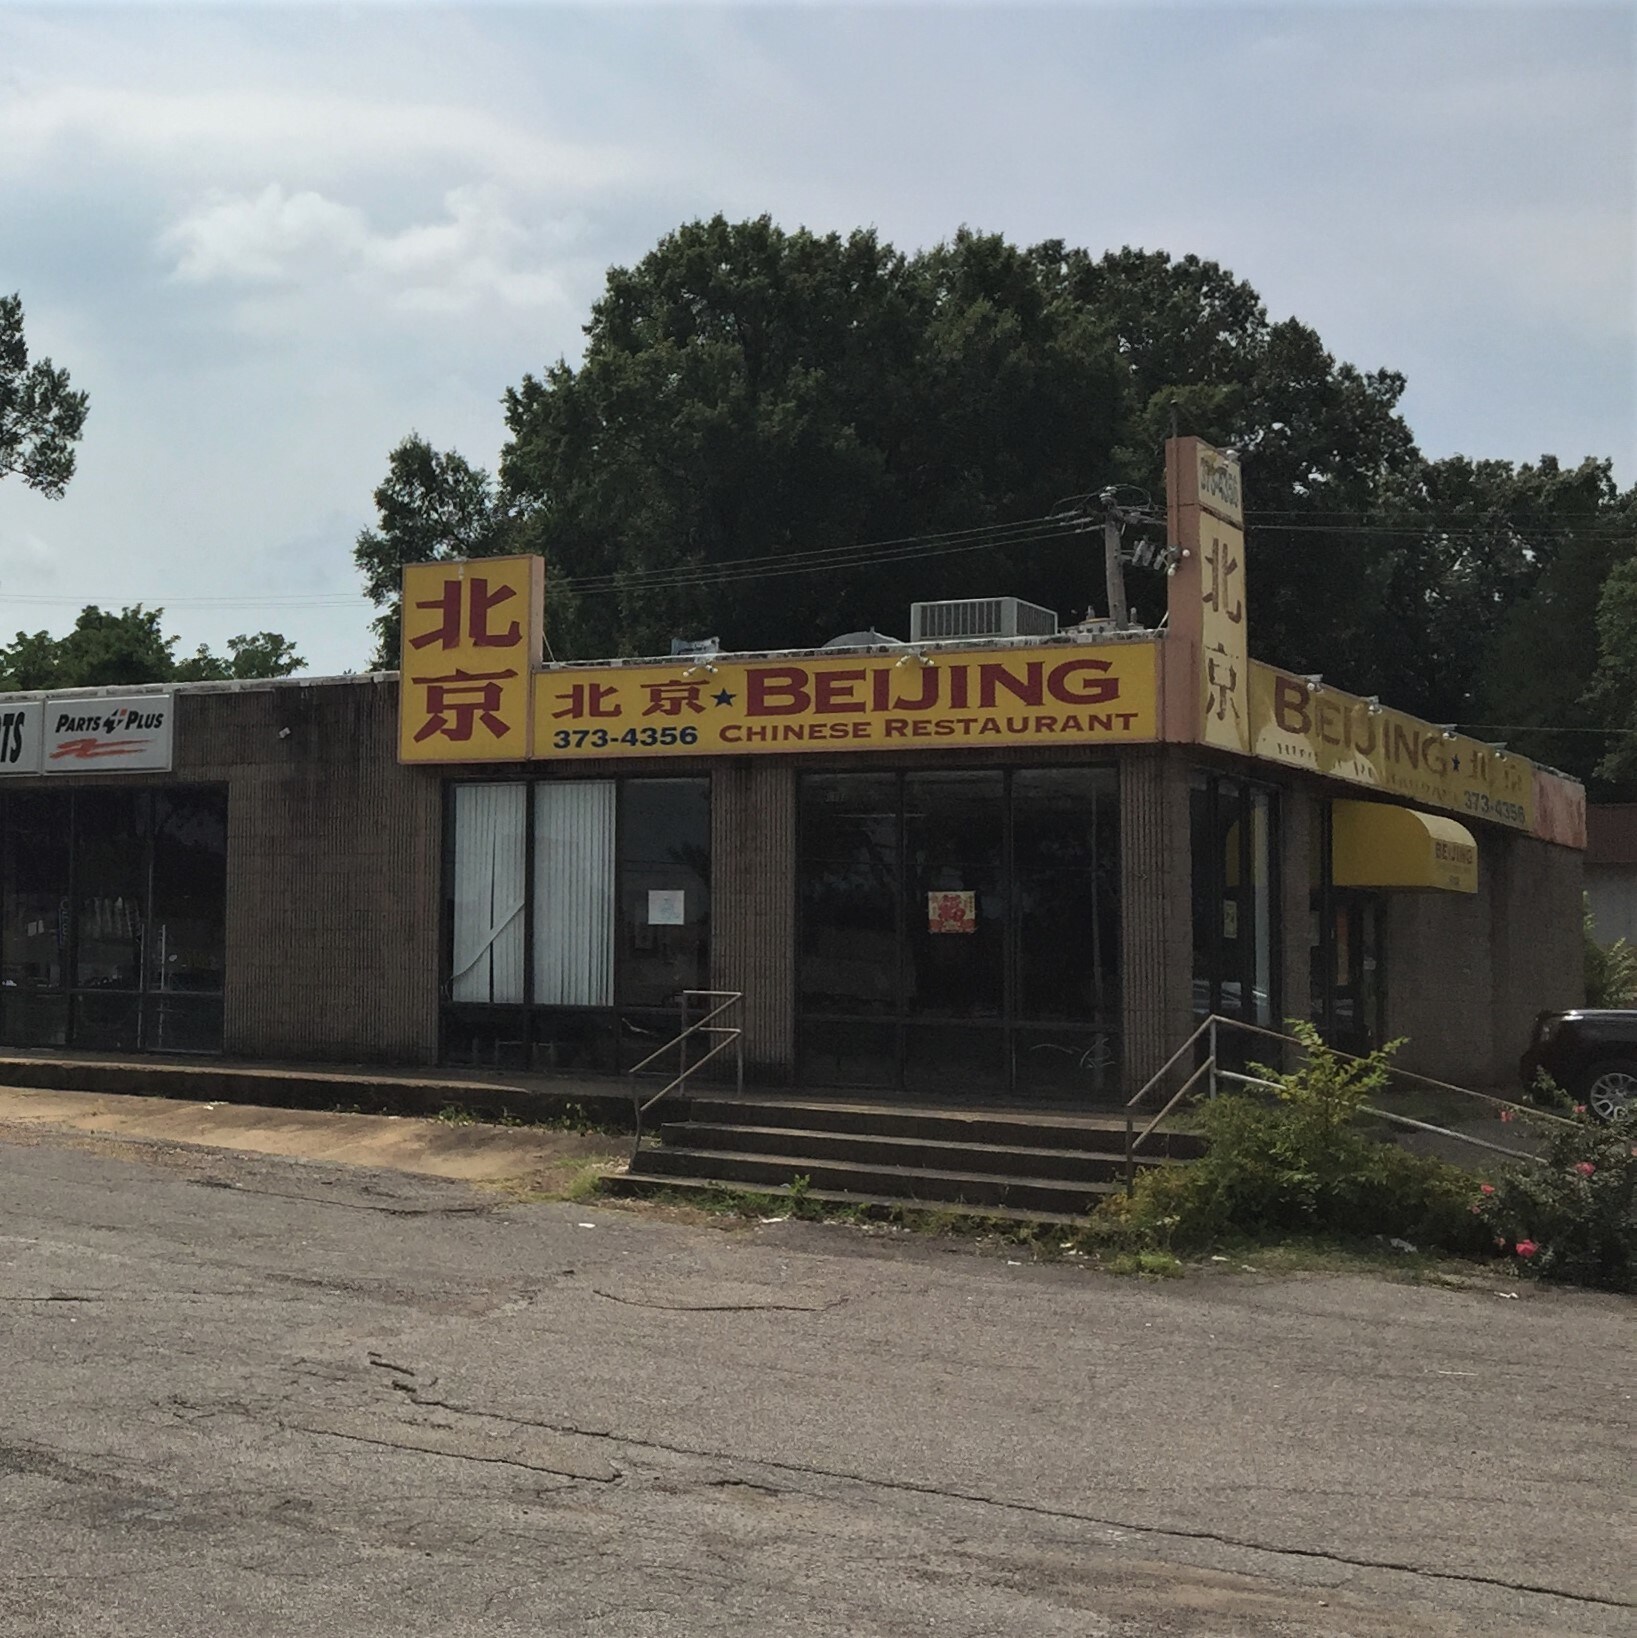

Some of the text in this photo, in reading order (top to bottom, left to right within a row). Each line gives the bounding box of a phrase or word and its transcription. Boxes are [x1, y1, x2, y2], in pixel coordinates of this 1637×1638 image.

[409, 578, 523, 743] 北京
[552, 679, 711, 719] 北京
[744, 659, 1121, 717] BEIJING
[56, 711, 164, 733] PARTS PLUS
[553, 726, 698, 749] 373-4356
[719, 712, 1138, 743] CHINESE RESTAURANT
[1274, 676, 1448, 777] BEIJING
